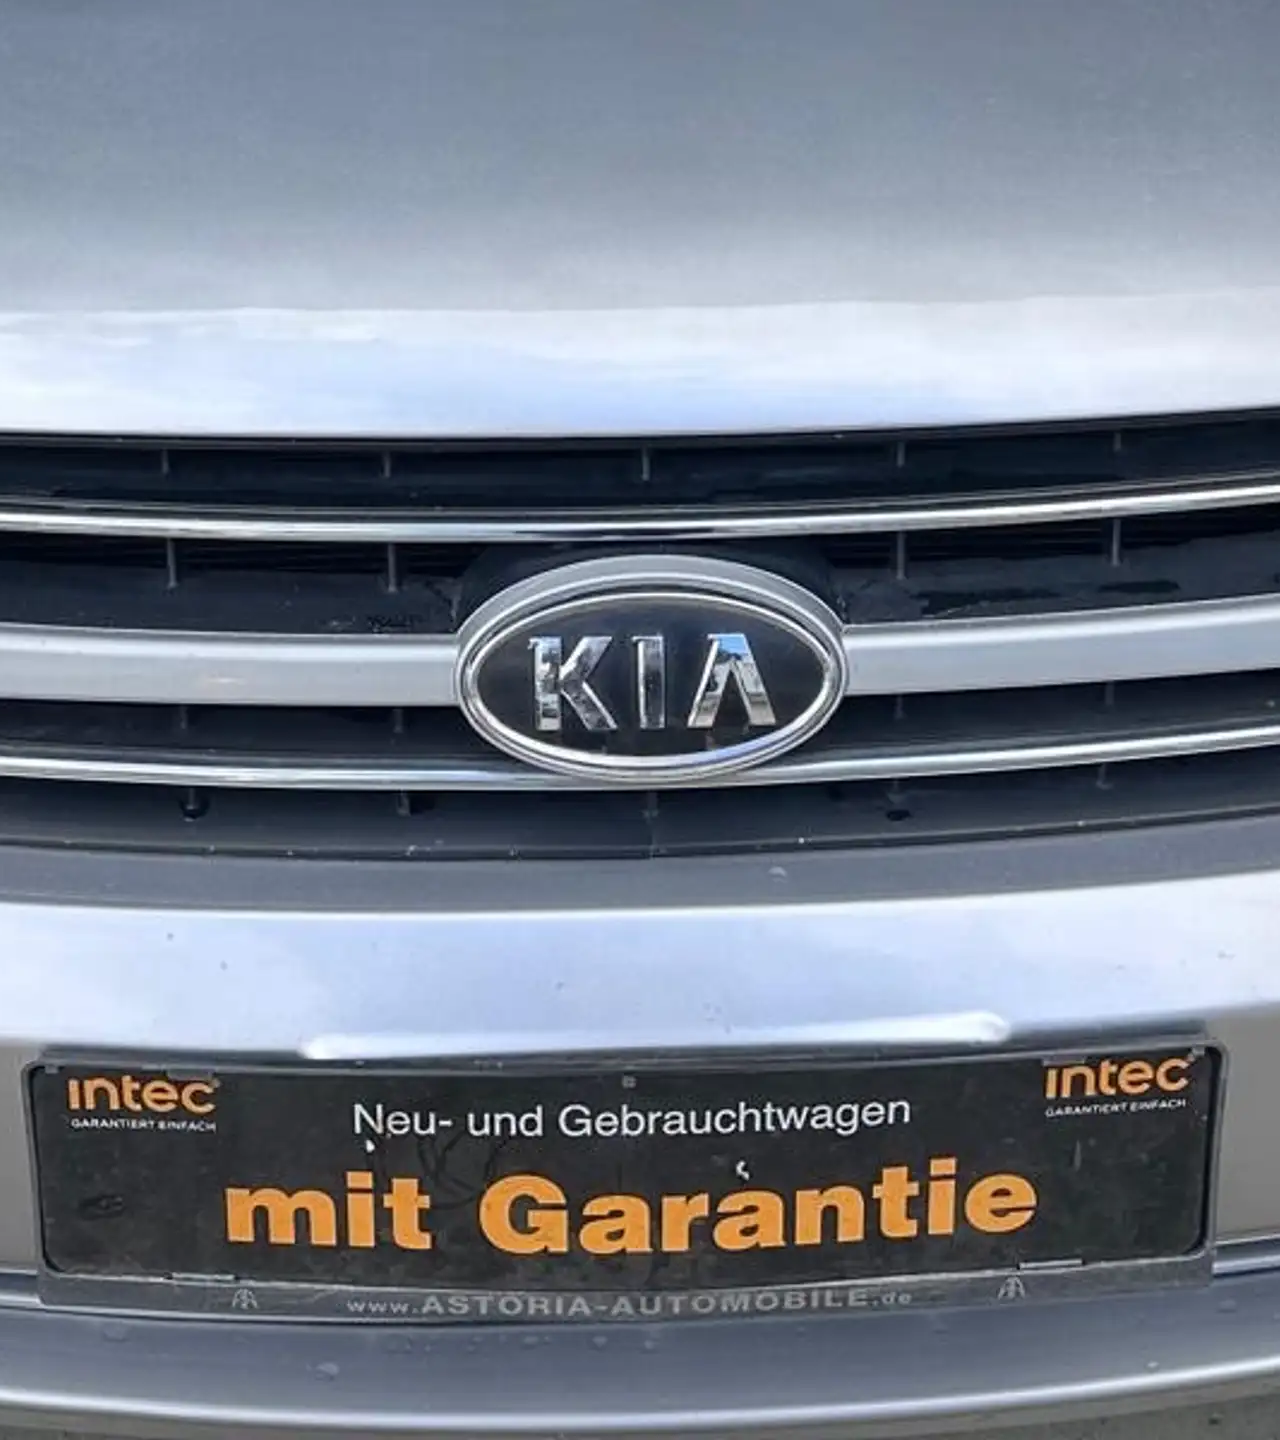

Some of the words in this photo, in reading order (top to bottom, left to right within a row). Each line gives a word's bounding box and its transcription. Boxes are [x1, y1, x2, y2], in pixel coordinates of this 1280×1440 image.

[528, 633, 777, 730] KIA
[67, 1074, 216, 1114] intec
[1045, 1057, 1190, 1100] intec
[71, 1117, 154, 1131] GARANTIERT
[157, 1119, 216, 1133] EINFACH
[353, 1103, 453, 1138] Neu-
[467, 1103, 544, 1138] und
[558, 1097, 912, 1138] Gebrauchtwagen
[1044, 1102, 1128, 1118] GARANTIERT
[1129, 1098, 1187, 1112] EINFACH
[225, 1170, 431, 1249] mit
[479, 1156, 1038, 1256] Garantie
[346, 1286, 913, 1318] www.ASTORIA-AUTOMOBILE.de
